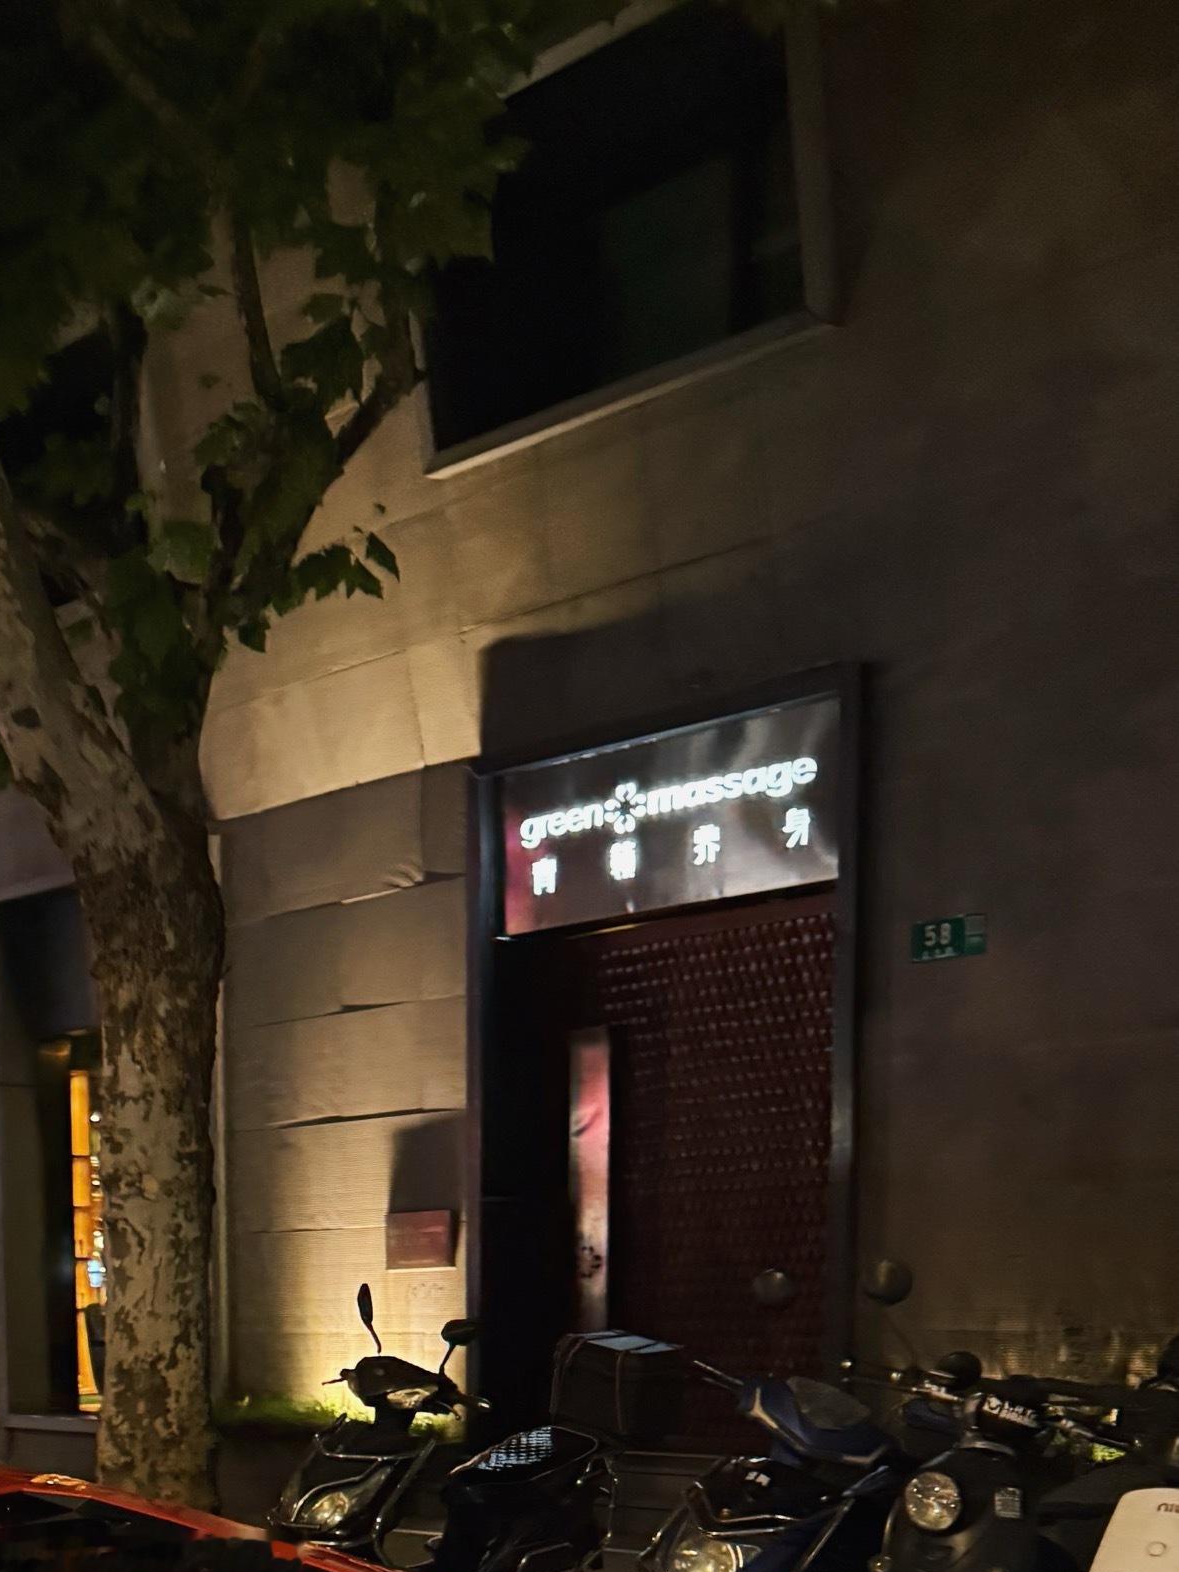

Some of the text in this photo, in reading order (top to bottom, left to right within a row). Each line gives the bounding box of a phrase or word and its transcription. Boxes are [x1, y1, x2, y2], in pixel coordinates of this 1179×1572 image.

[520, 756, 818, 849] green massage
[924, 922, 952, 947] 58
